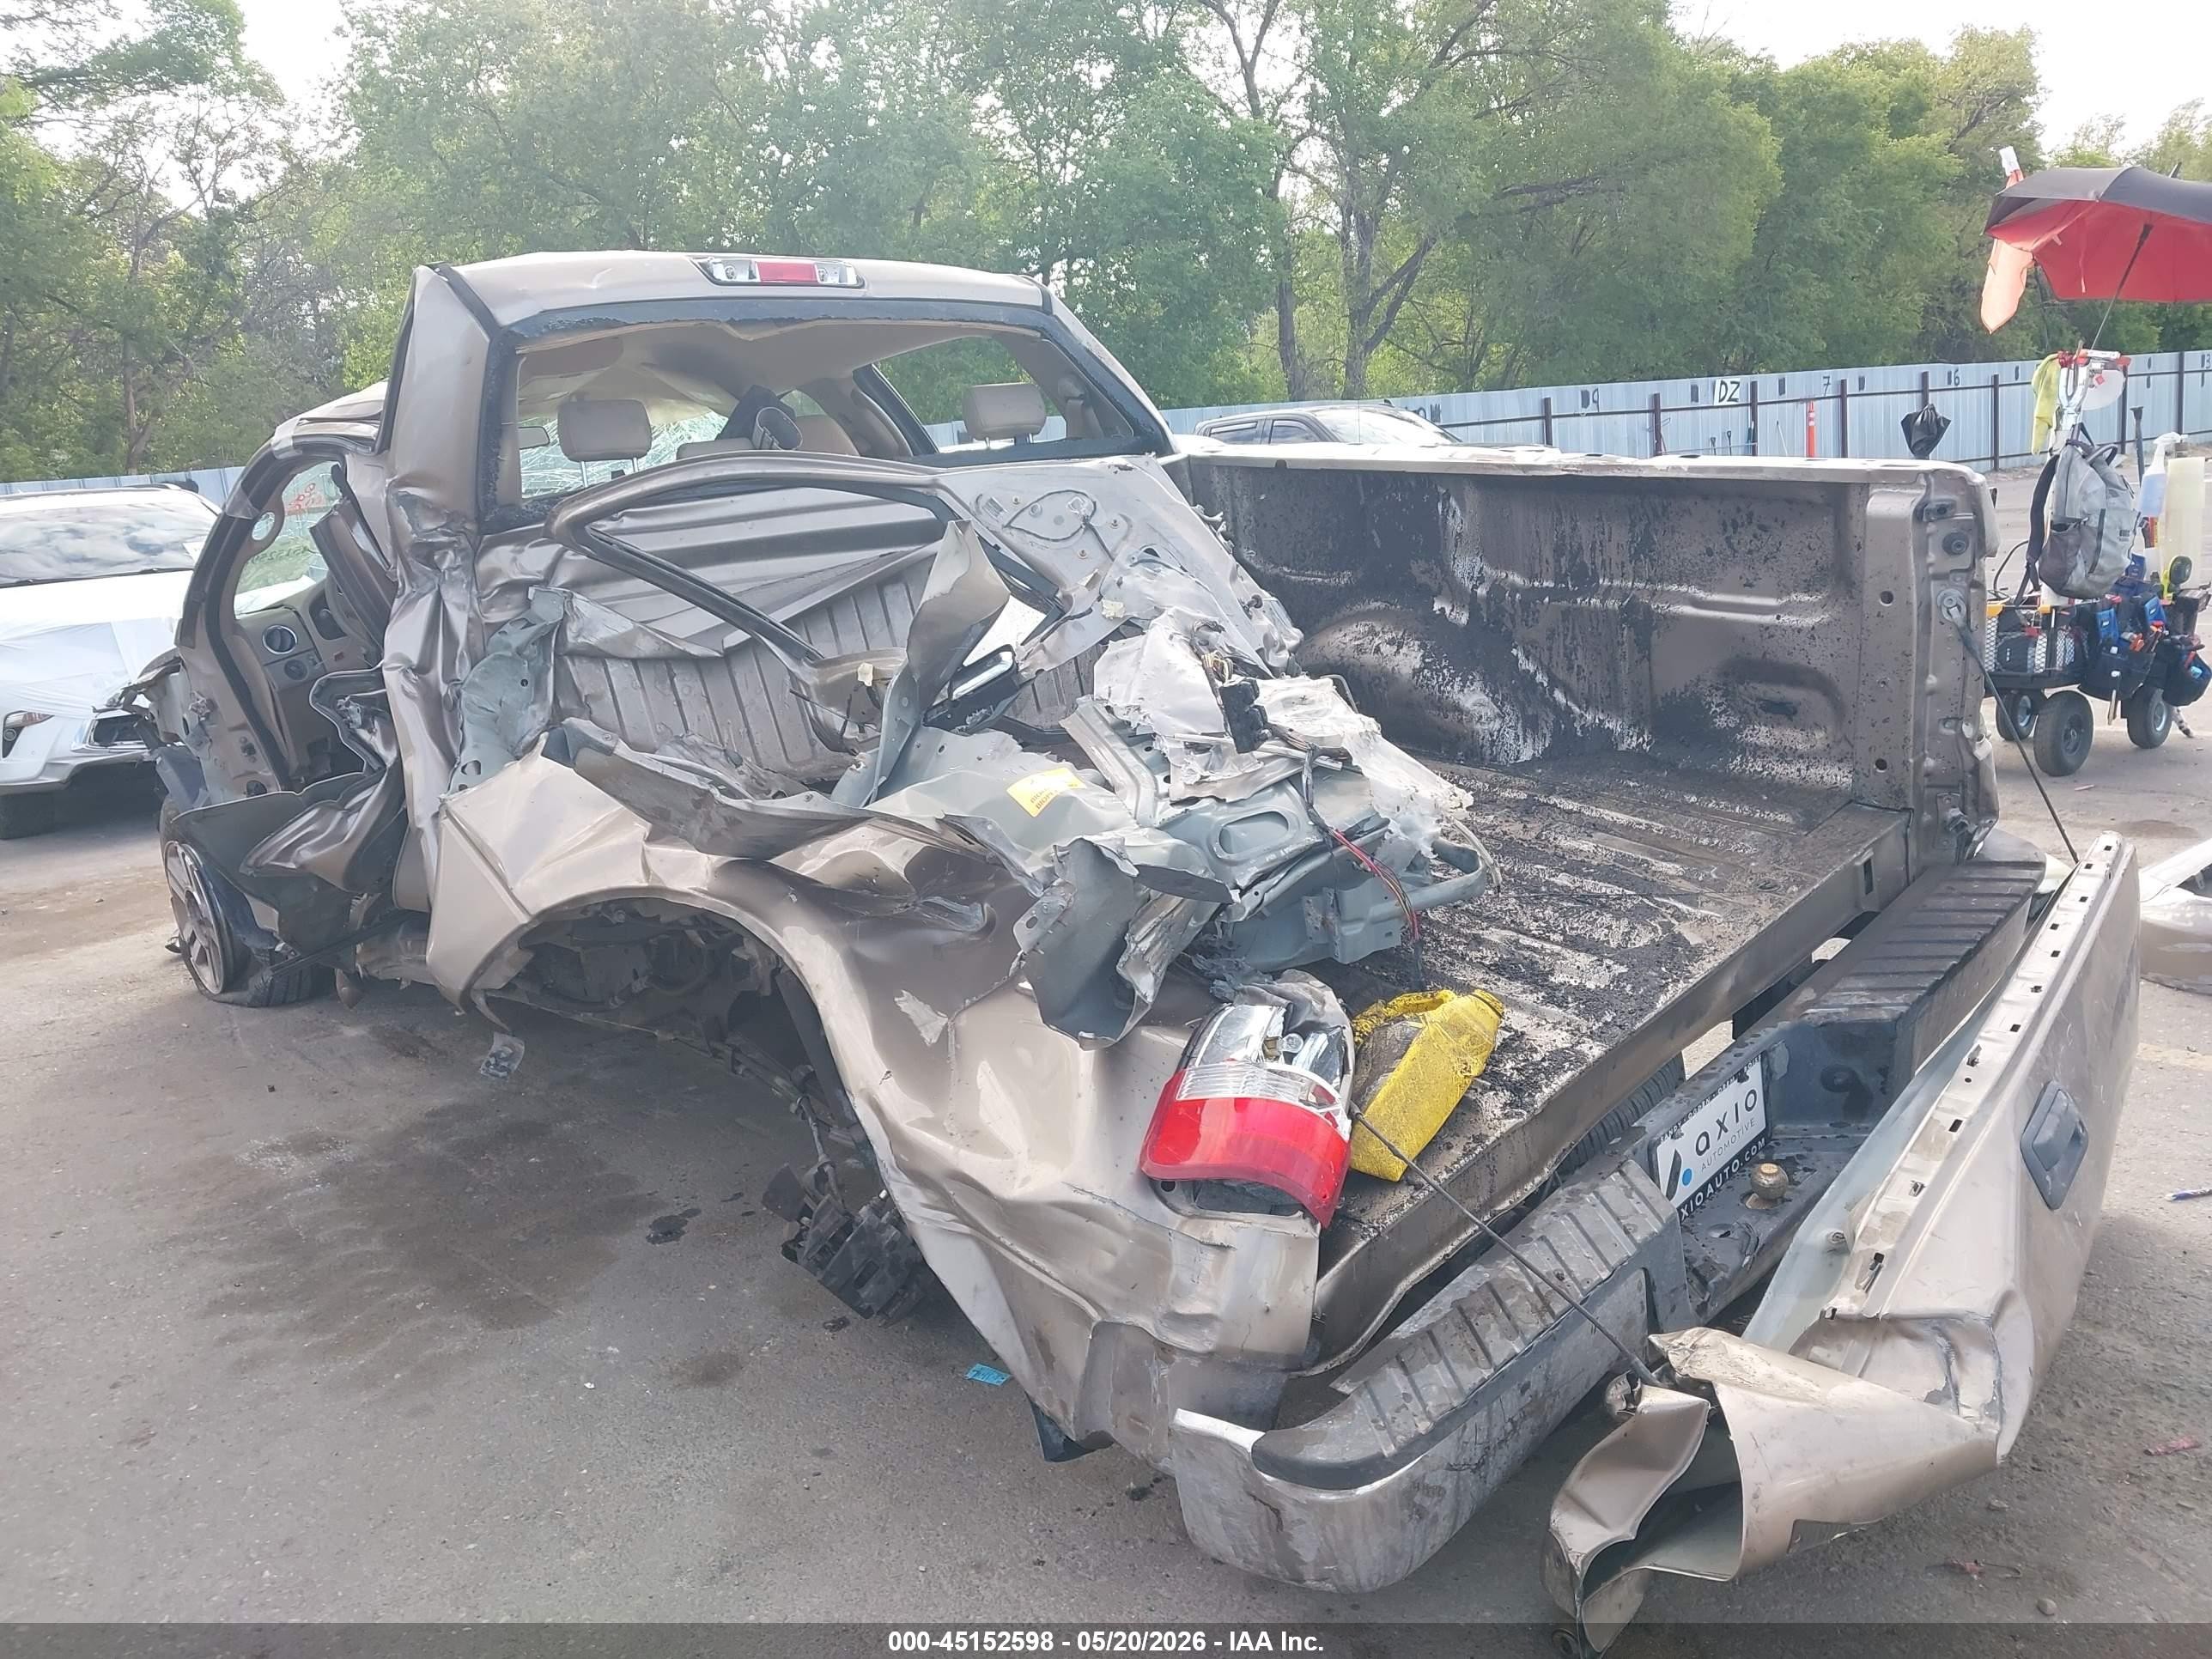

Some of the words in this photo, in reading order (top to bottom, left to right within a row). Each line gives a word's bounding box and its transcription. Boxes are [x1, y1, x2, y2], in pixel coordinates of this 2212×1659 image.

[1718, 379, 1741, 404] DZ
[1822, 375, 1832, 396] 7
[1660, 1121, 1682, 1142] SANDY
[1687, 1097, 1711, 1118] OGDEN
[1700, 1118, 1756, 1172] AUTOMOTIVE
[1680, 1137, 1766, 1220] XIOAUTO.COM
